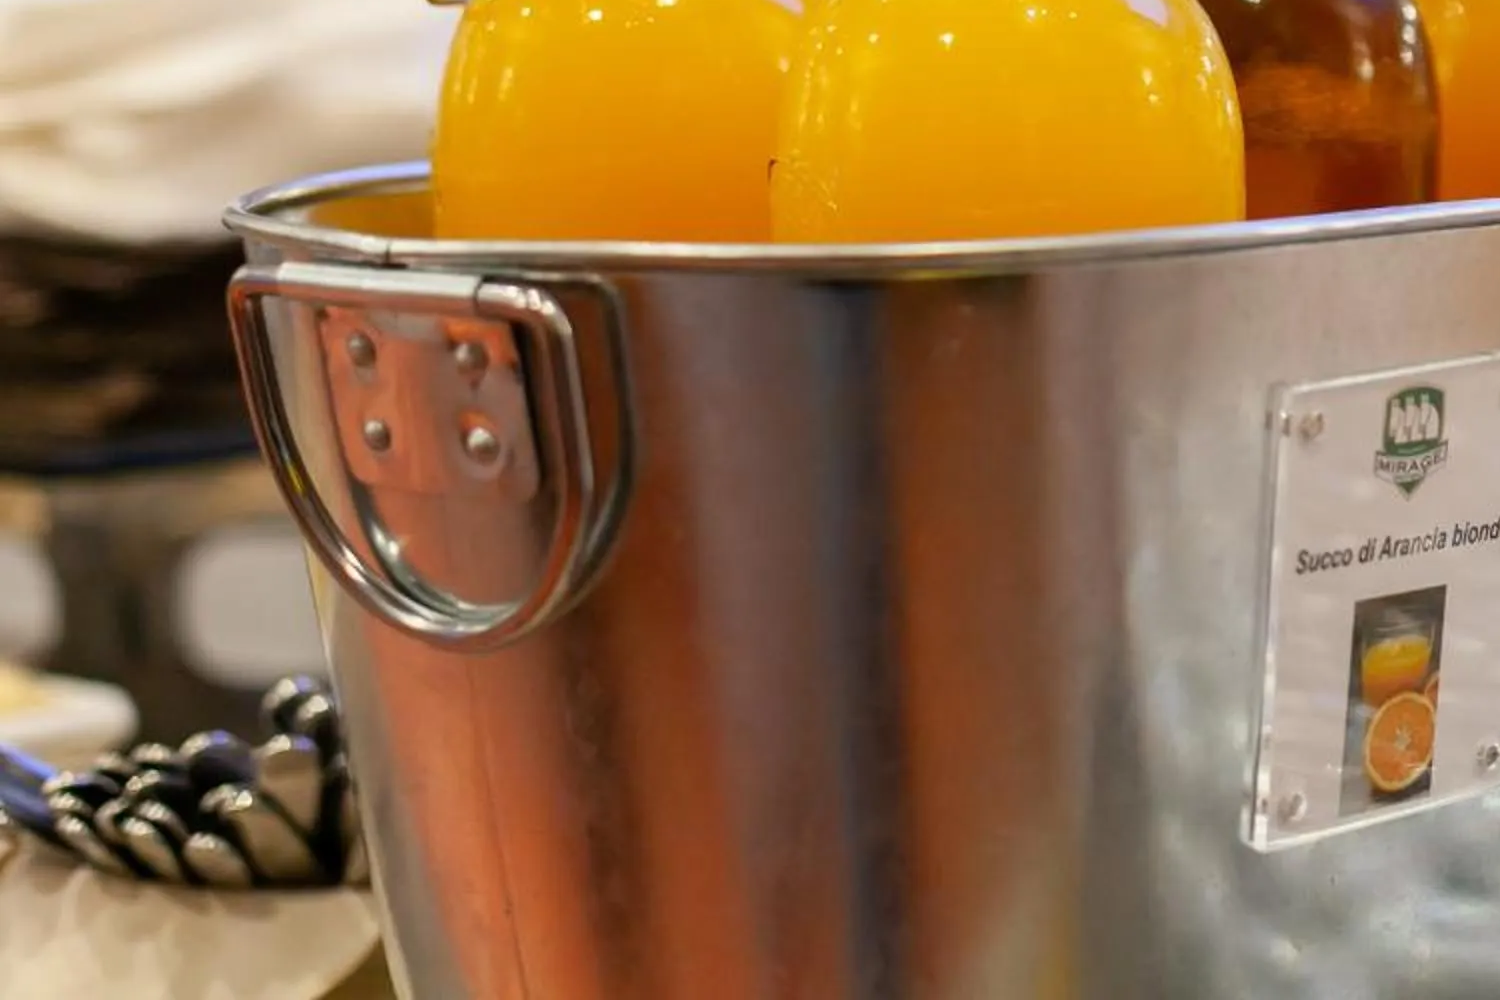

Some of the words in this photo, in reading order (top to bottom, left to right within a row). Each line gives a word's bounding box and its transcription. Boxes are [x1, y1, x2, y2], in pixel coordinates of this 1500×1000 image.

[1379, 448, 1442, 474] MIRAGE
[1296, 549, 1354, 575] Succo
[1358, 537, 1378, 564] di
[1378, 527, 1448, 561] Arancia
